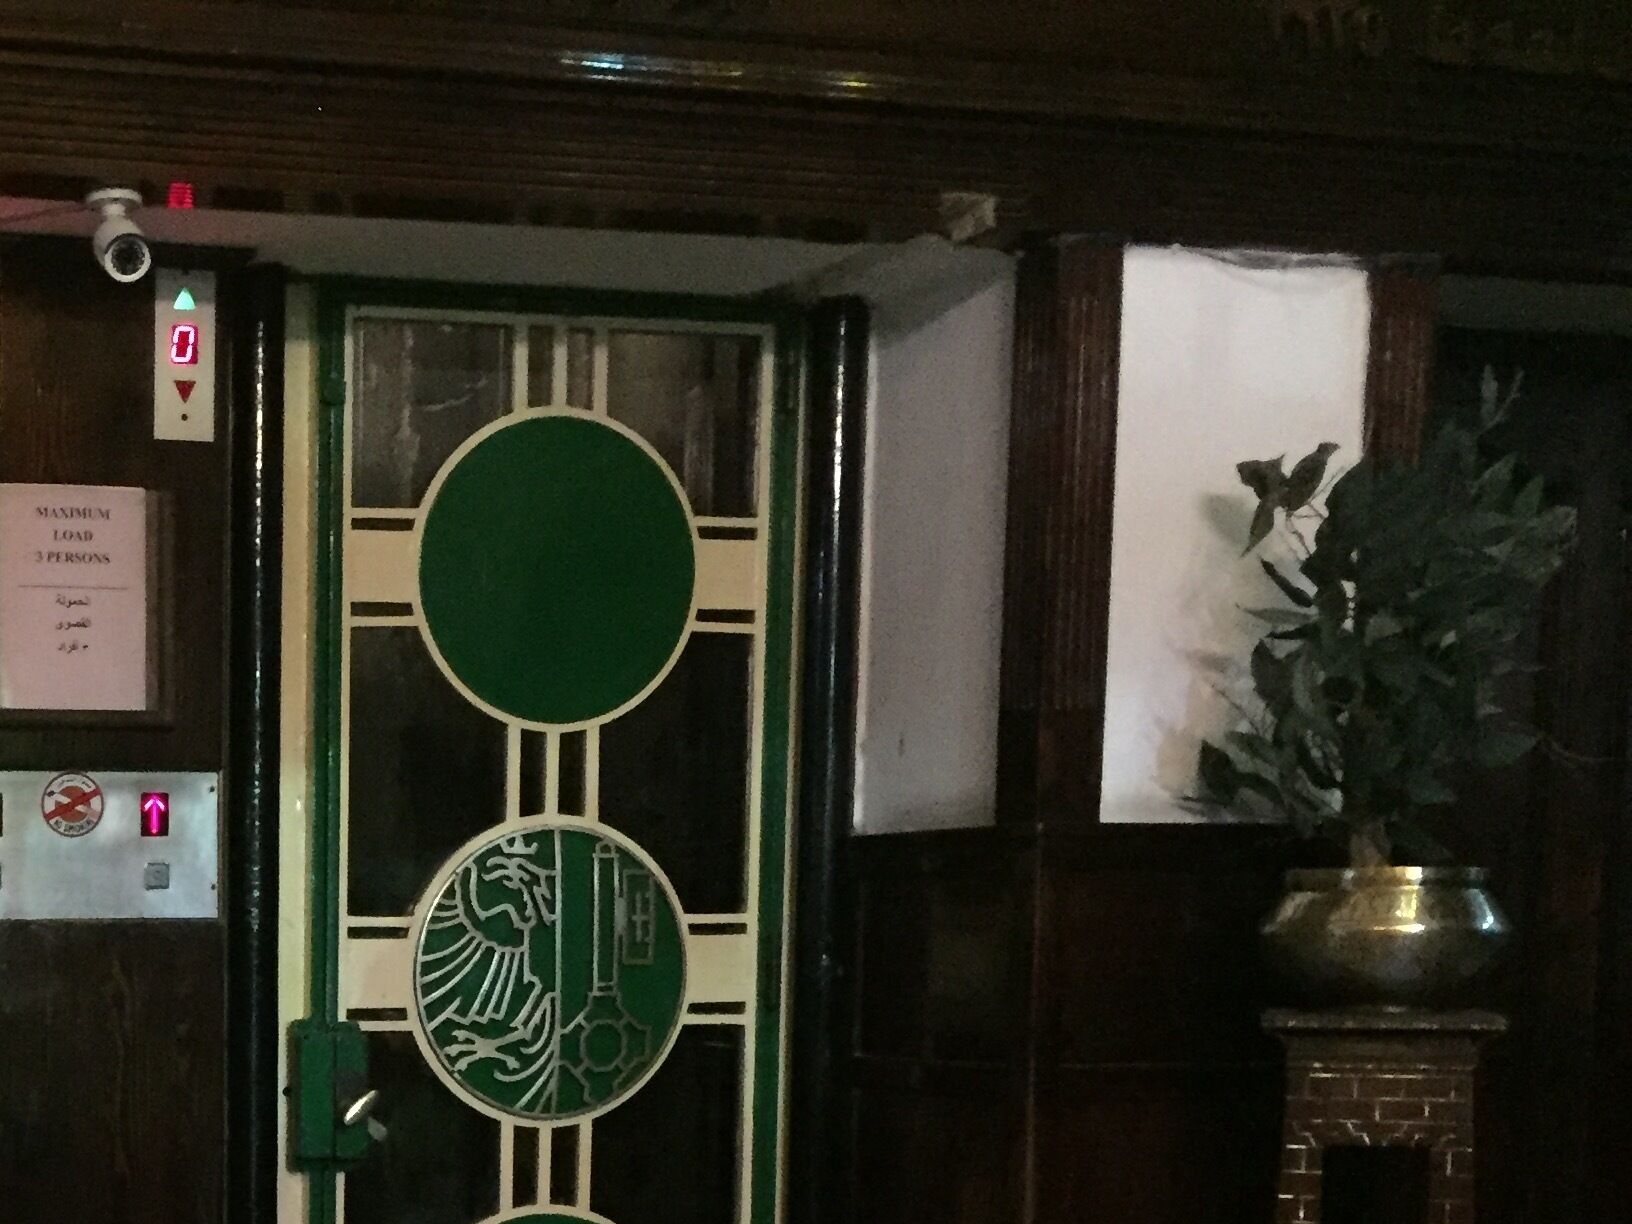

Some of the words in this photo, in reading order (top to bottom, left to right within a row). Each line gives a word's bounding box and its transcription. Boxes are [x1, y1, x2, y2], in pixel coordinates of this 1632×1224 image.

[169, 325, 196, 363] 0
[35, 506, 111, 521] MAXIMUM
[52, 528, 94, 542] LOAD
[34, 550, 44, 564] 3
[46, 550, 111, 565] PERSONS
